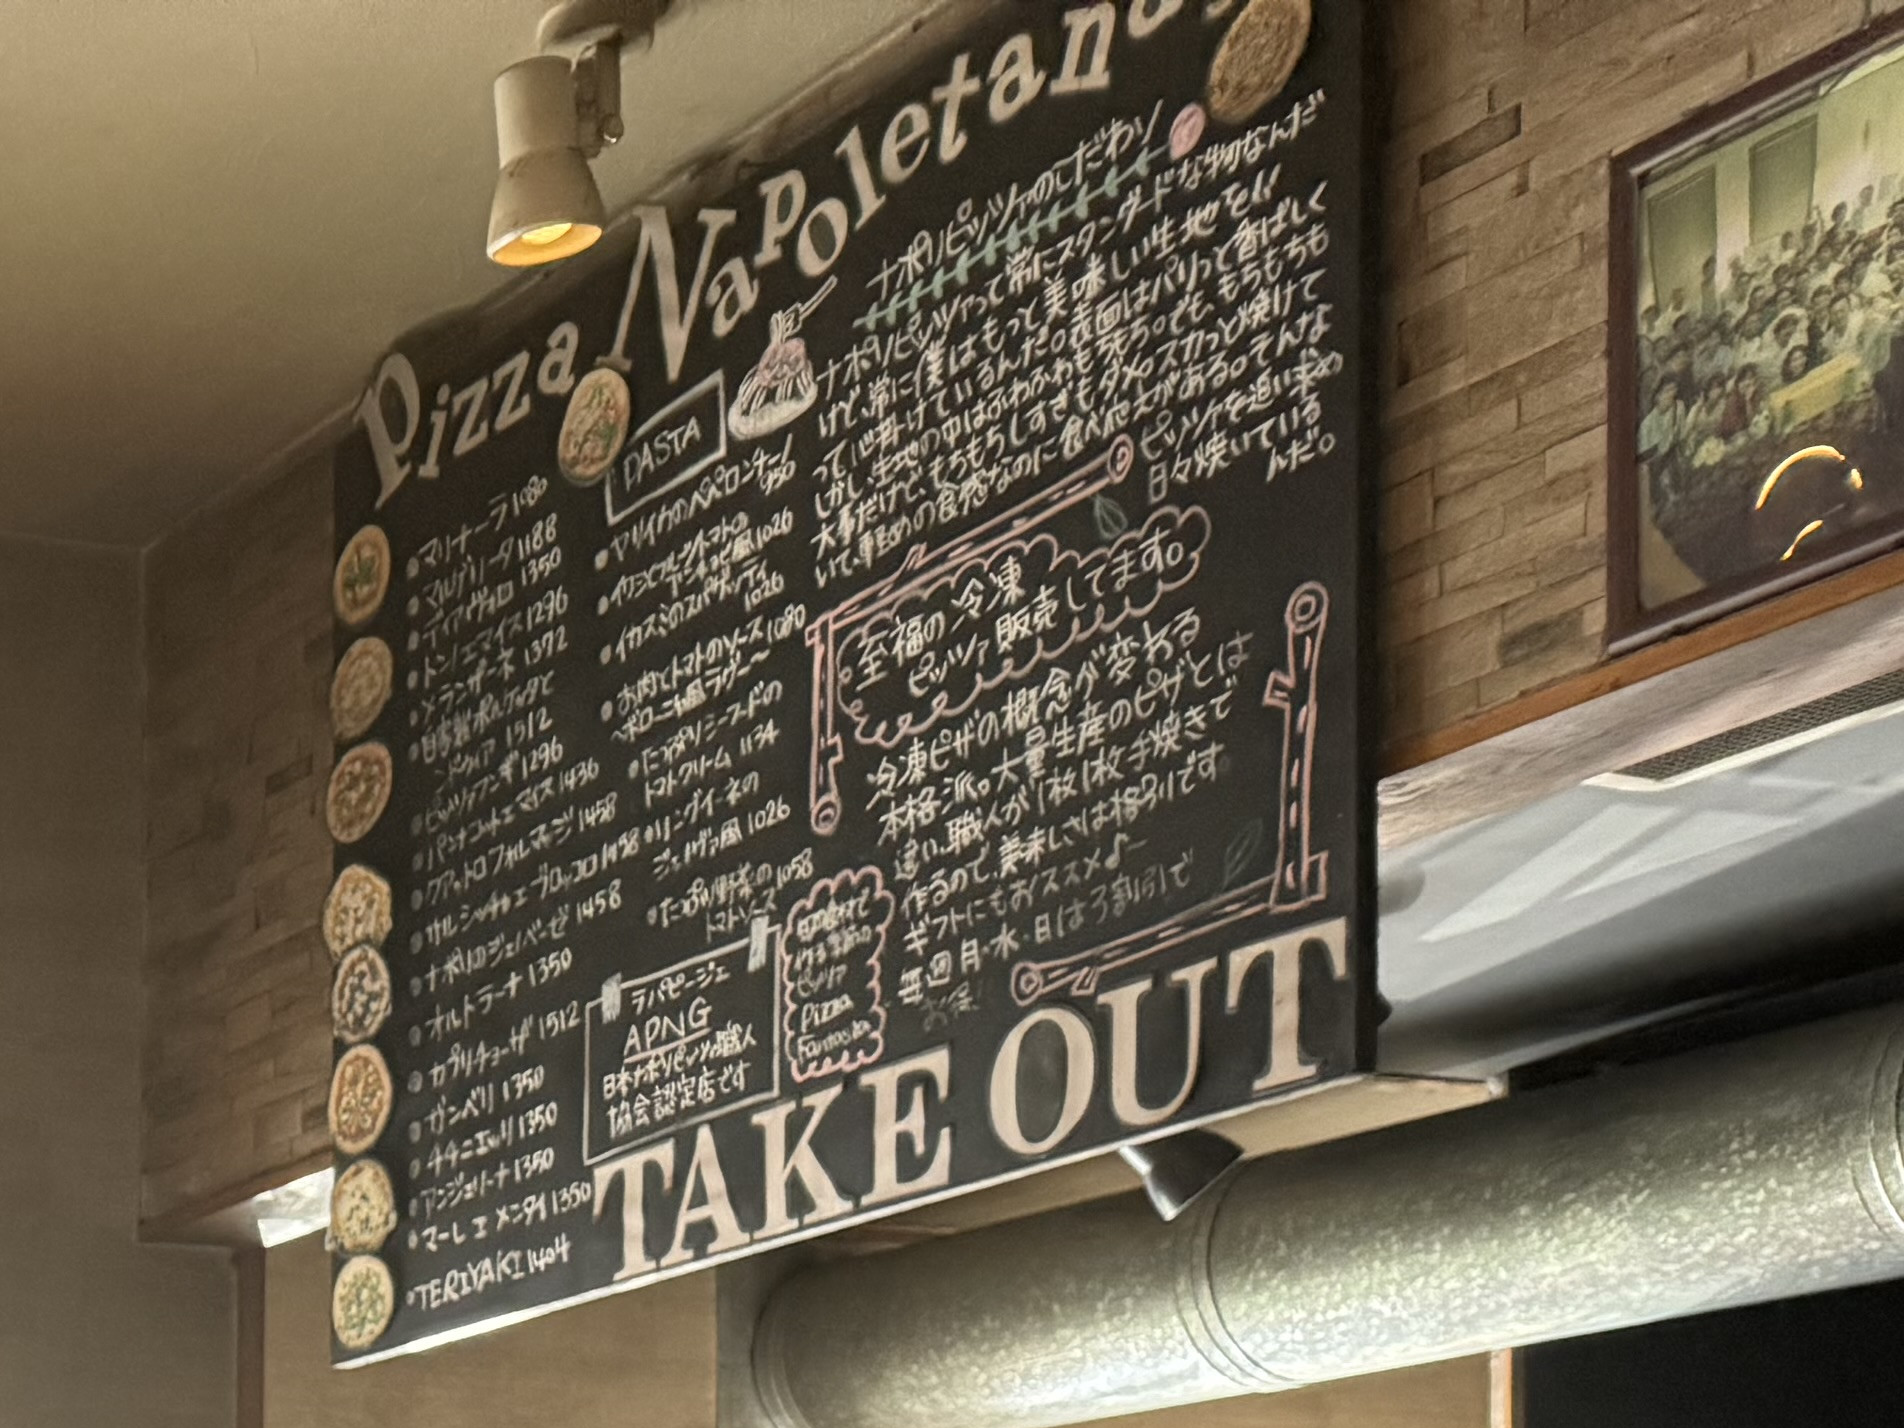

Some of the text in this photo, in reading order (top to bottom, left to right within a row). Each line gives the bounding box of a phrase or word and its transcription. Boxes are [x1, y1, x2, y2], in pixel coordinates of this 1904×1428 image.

[355, 321, 580, 512] Pizza
[623, 415, 701, 491] PASTA
[517, 512, 557, 560] 1188
[521, 545, 561, 586] 1350
[526, 584, 568, 631] 1296
[524, 624, 568, 665] 1372
[862, 606, 1204, 811] 冷凍ピザの概念が変わる
[521, 734, 563, 779] 1296
[747, 794, 790, 834] 1026
[576, 878, 621, 922] 1458
[528, 946, 572, 986] 1350
[622, 995, 712, 1058] APNG
[502, 1064, 544, 1101] 1350
[594, 917, 1349, 1281] TAKE OUT
[518, 1100, 557, 1138] 1350
[412, 1249, 525, 1310] TERIYAKI
